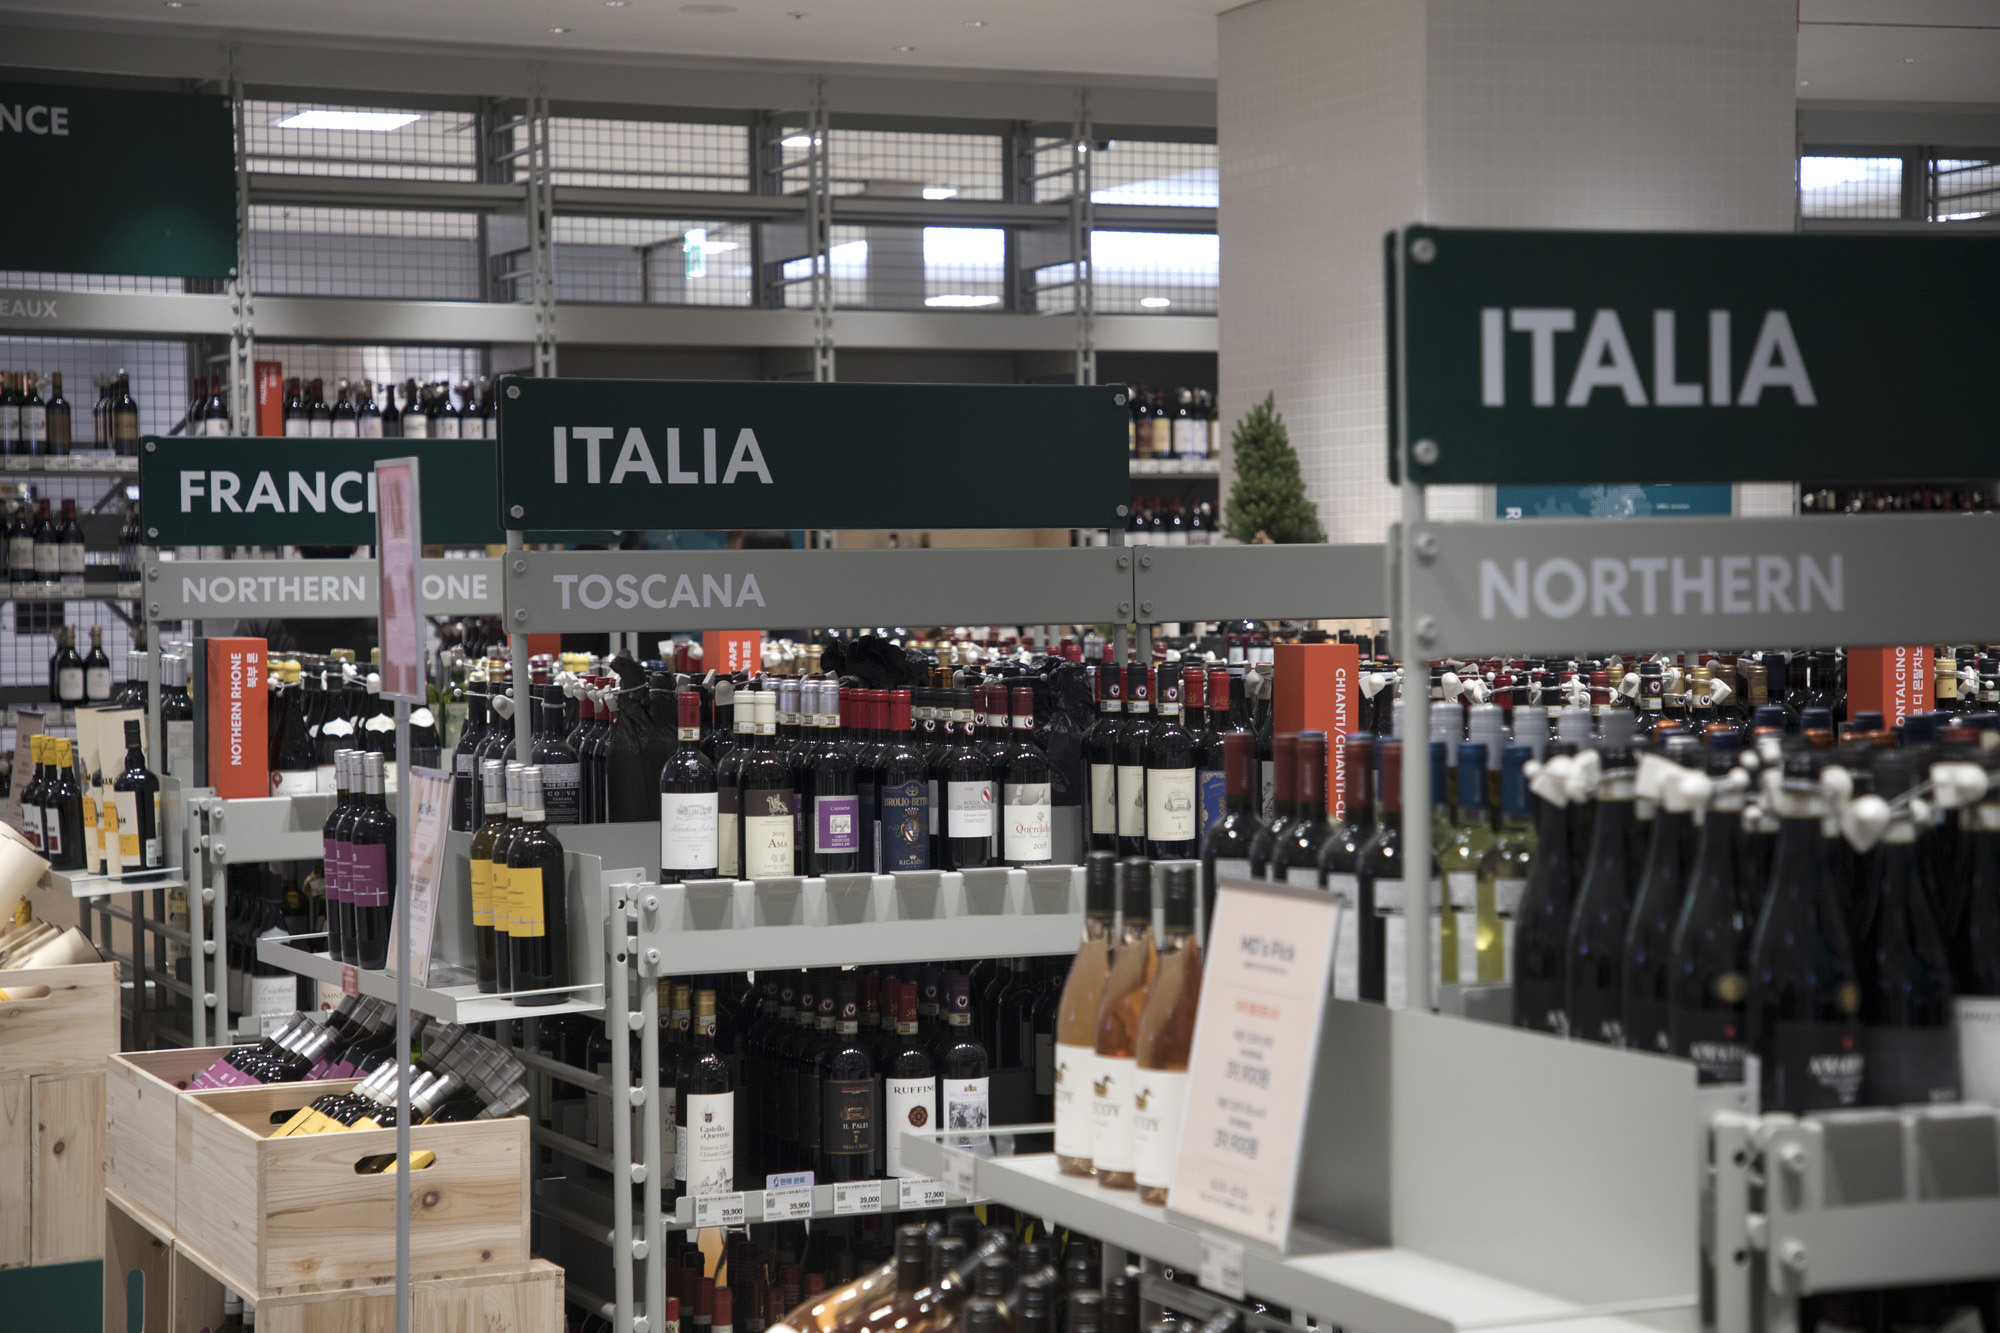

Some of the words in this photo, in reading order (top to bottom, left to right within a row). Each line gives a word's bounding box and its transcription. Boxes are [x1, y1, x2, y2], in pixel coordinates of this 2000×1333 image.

[0, 103, 70, 136] NCE
[1481, 307, 1816, 408] ITALIA
[553, 426, 774, 485] ITALIA
[182, 575, 366, 603] NORTHERN
[552, 573, 767, 611] TOSCANA
[1477, 554, 1844, 622] NORTHERN
[231, 652, 242, 699] RHONE
[231, 702, 242, 766] NOTHERN
[898, 857, 925, 866] RICASOLI
[699, 1124, 725, 1133] Castello
[789, 1201, 810, 1210] 39,900
[859, 1196, 880, 1204] 39,000
[924, 1191, 945, 1199] 37,900
[721, 1208, 743, 1216] 39,900
